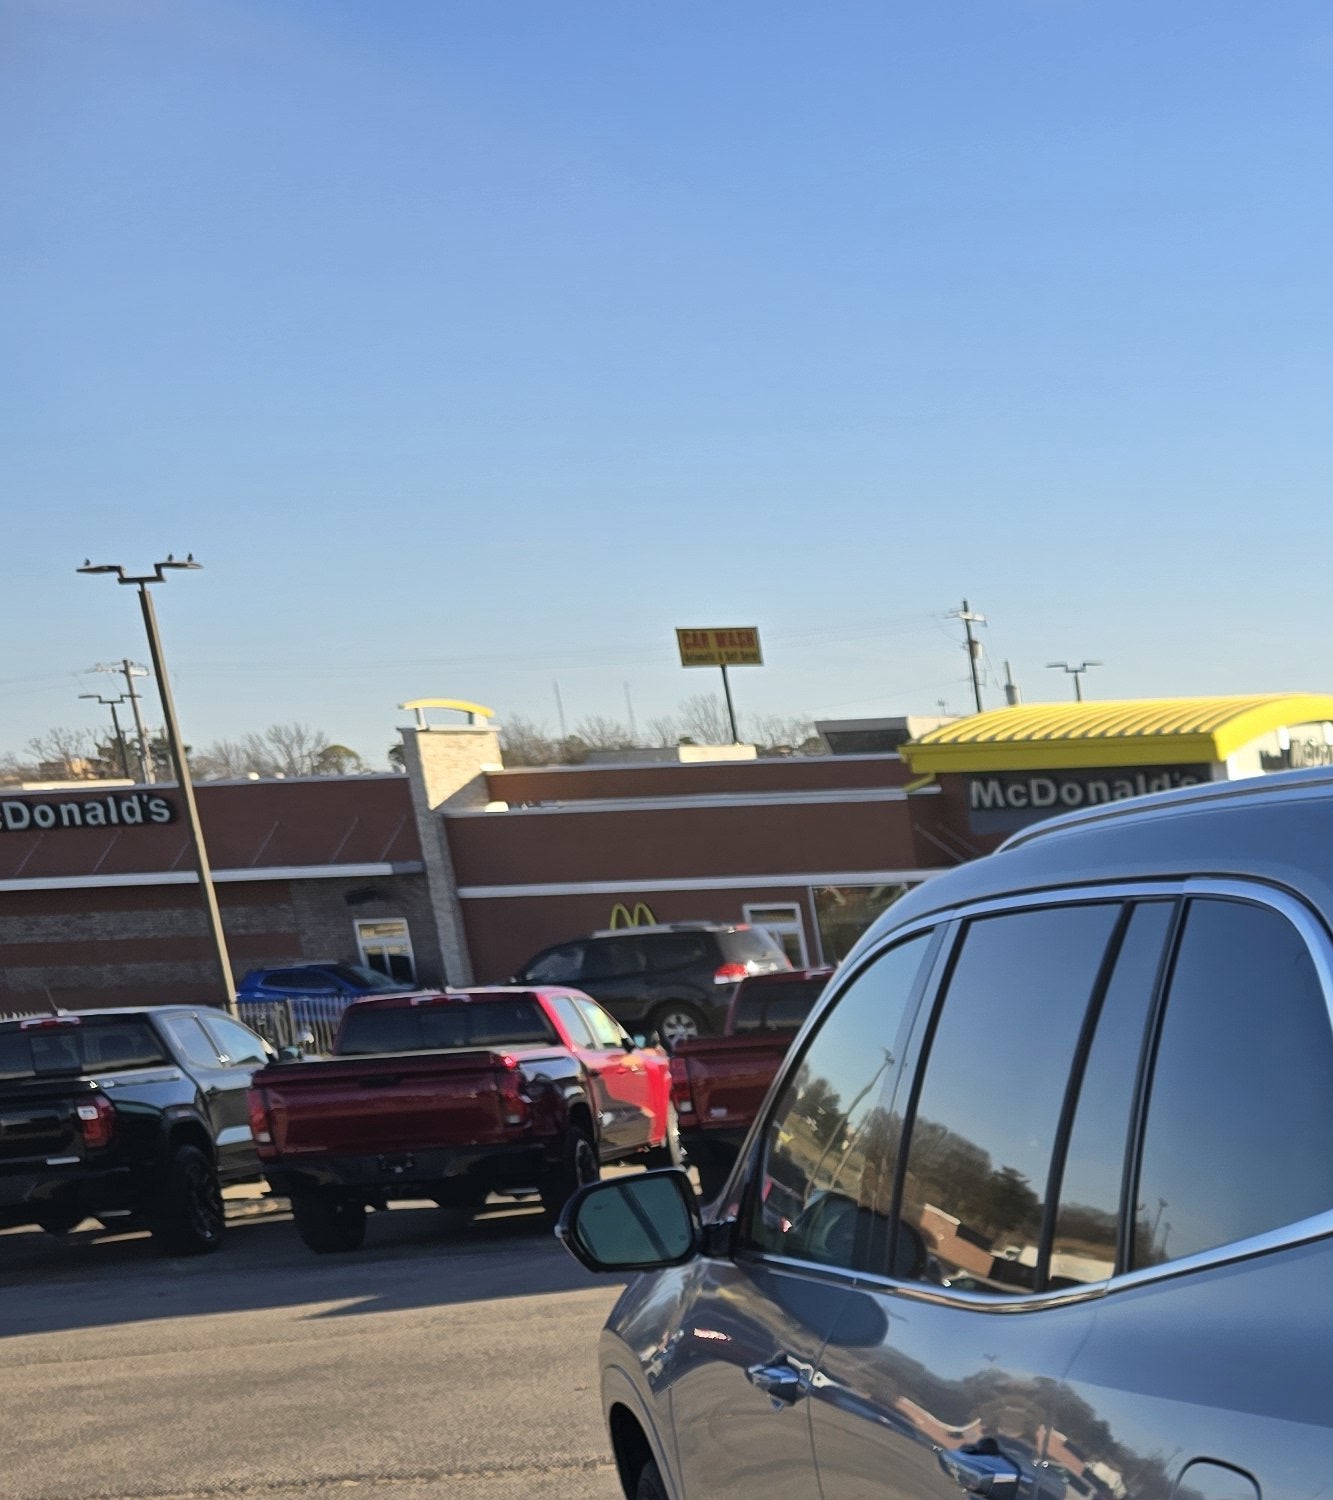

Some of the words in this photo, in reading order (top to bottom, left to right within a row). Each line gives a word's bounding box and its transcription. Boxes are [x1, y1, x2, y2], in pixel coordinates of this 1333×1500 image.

[682, 632, 710, 650] CAR
[714, 630, 755, 649] WASH
[970, 772, 1199, 809] McDonald's
